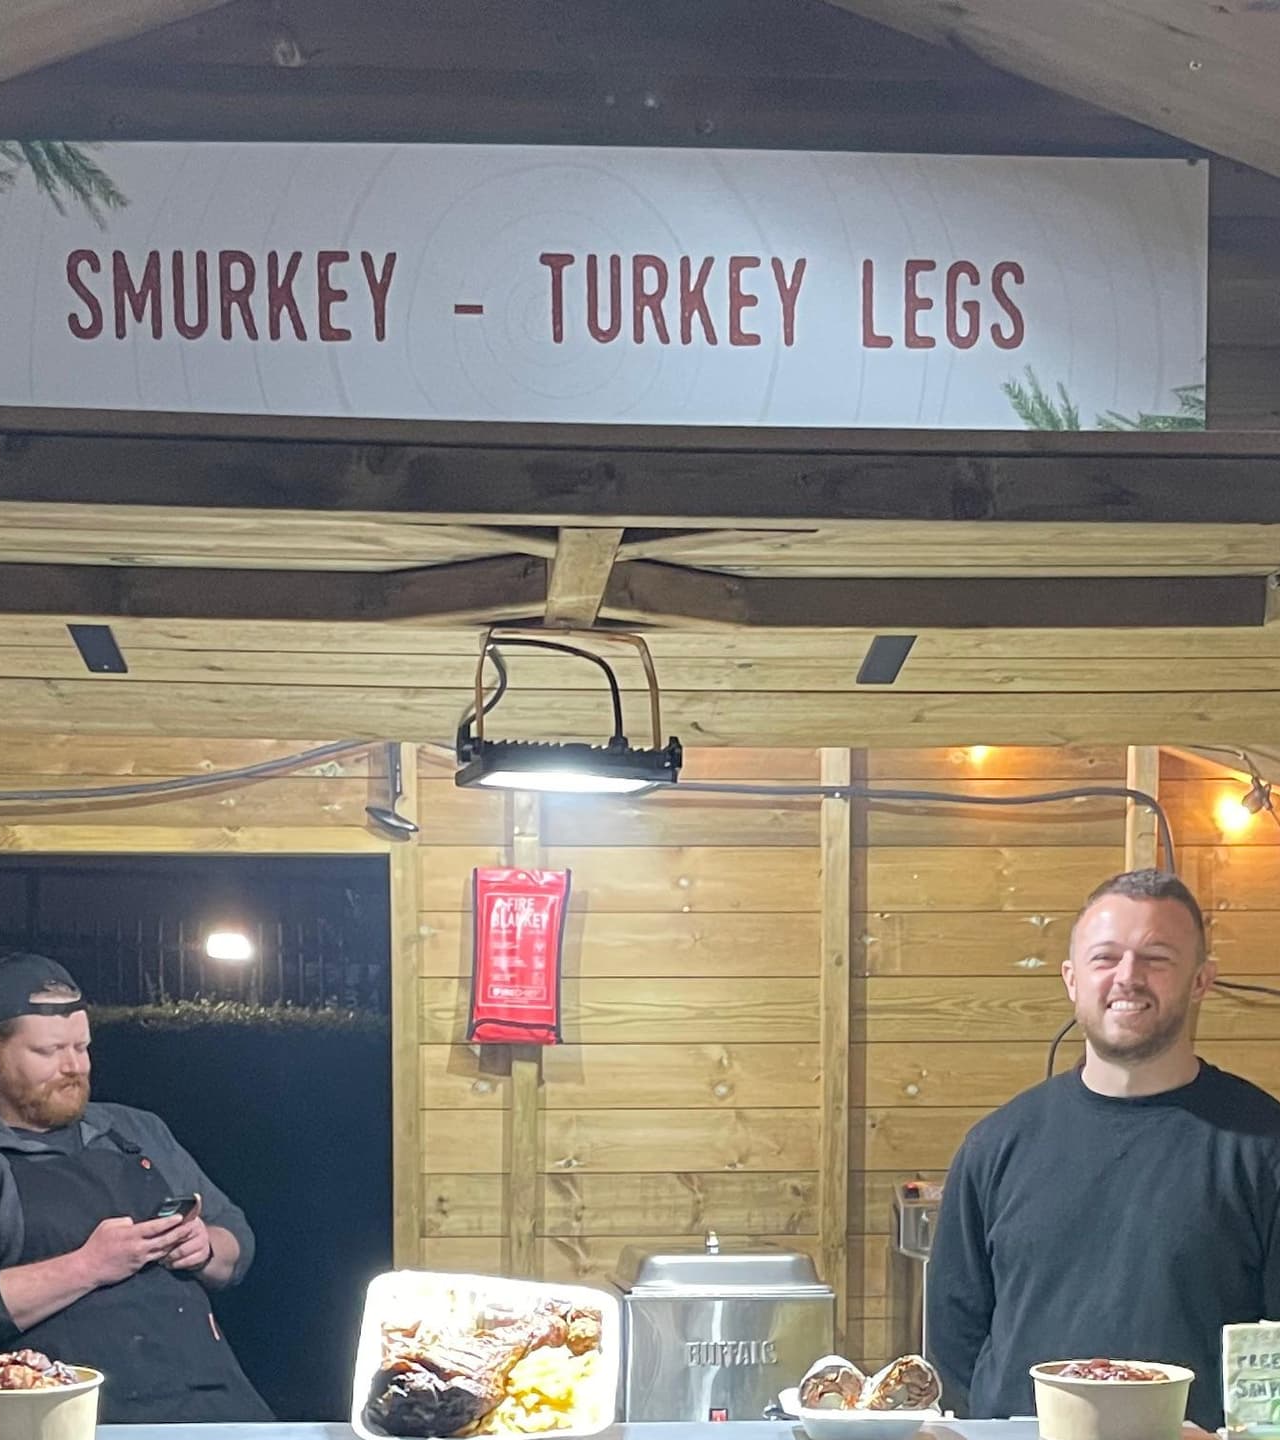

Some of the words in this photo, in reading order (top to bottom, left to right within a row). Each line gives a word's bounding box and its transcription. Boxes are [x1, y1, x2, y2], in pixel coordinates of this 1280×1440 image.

[66, 248, 397, 342] SMURKEY
[539, 251, 808, 347] TURKEY
[860, 259, 1027, 350] LEGS
[506, 897, 535, 913] FIRE
[685, 1341, 778, 1367] BUFFALO
